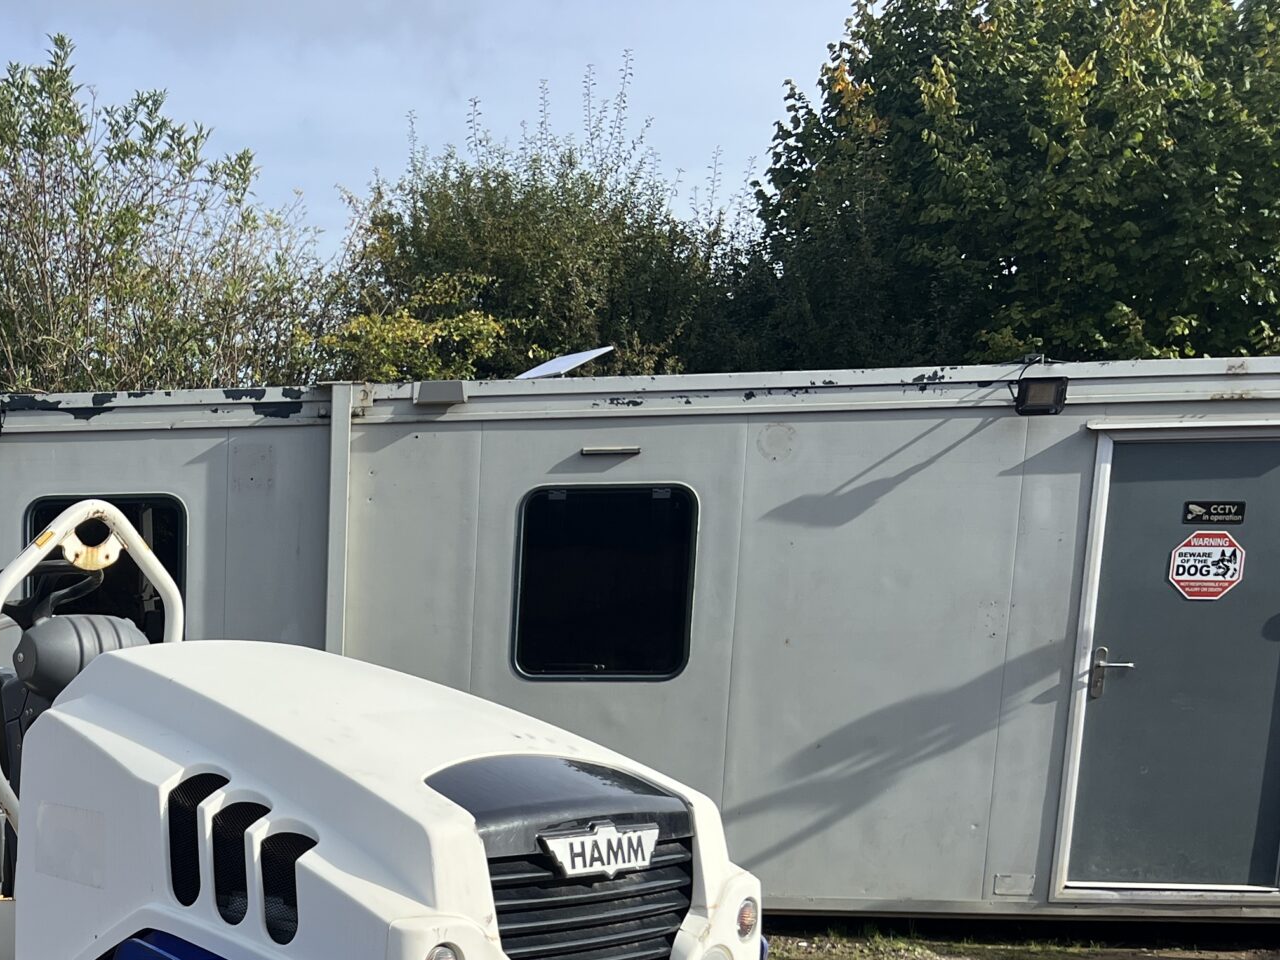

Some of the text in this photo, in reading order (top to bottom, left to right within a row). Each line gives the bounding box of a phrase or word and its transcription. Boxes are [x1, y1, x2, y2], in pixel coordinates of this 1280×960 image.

[1210, 504, 1238, 514] CCTV
[1210, 514, 1242, 522] operation
[1190, 537, 1230, 546] WARNING
[1175, 564, 1211, 577] DOG
[568, 834, 646, 870] HAMM
